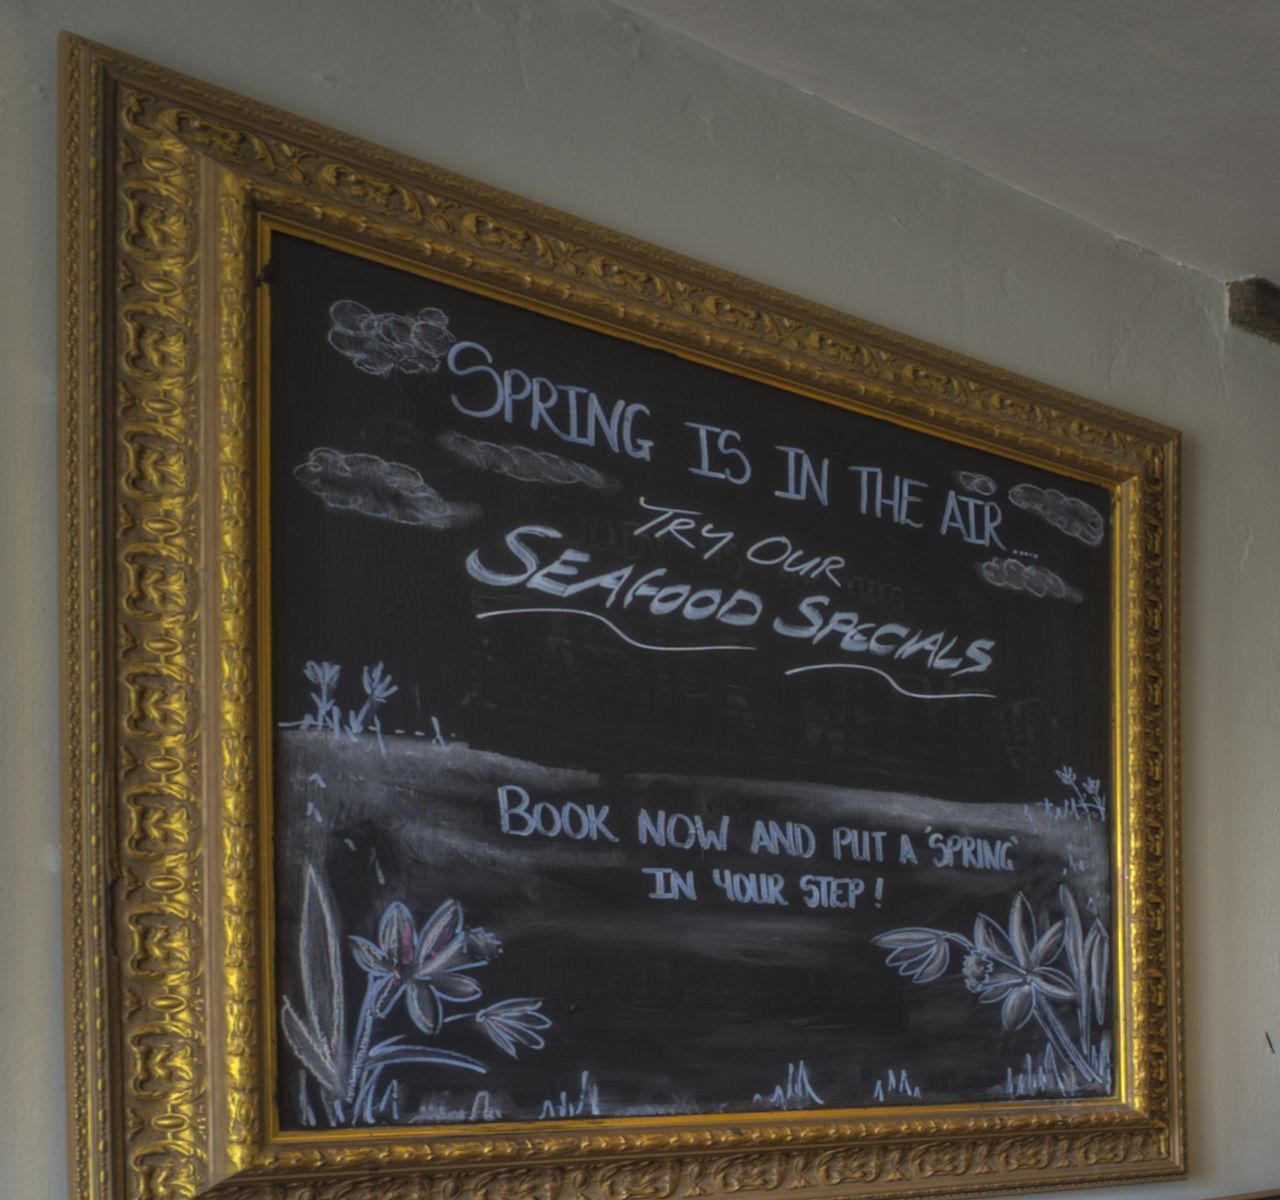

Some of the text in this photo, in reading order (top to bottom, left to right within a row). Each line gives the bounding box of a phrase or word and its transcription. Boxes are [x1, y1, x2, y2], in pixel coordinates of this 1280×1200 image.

[447, 340, 654, 462] SPRING
[684, 420, 752, 486] IS
[776, 444, 831, 508] IN
[849, 464, 928, 530] THE
[628, 496, 846, 588] TRY OUR
[464, 524, 996, 678] SEAFOOD SPECIALS
[496, 784, 619, 846] BOOK
[638, 808, 730, 854] NOW
[750, 817, 816, 860] AND
[832, 826, 888, 866] PUT
[898, 832, 918, 866] A
[641, 864, 698, 903] IN
[715, 871, 788, 908] YOUR
